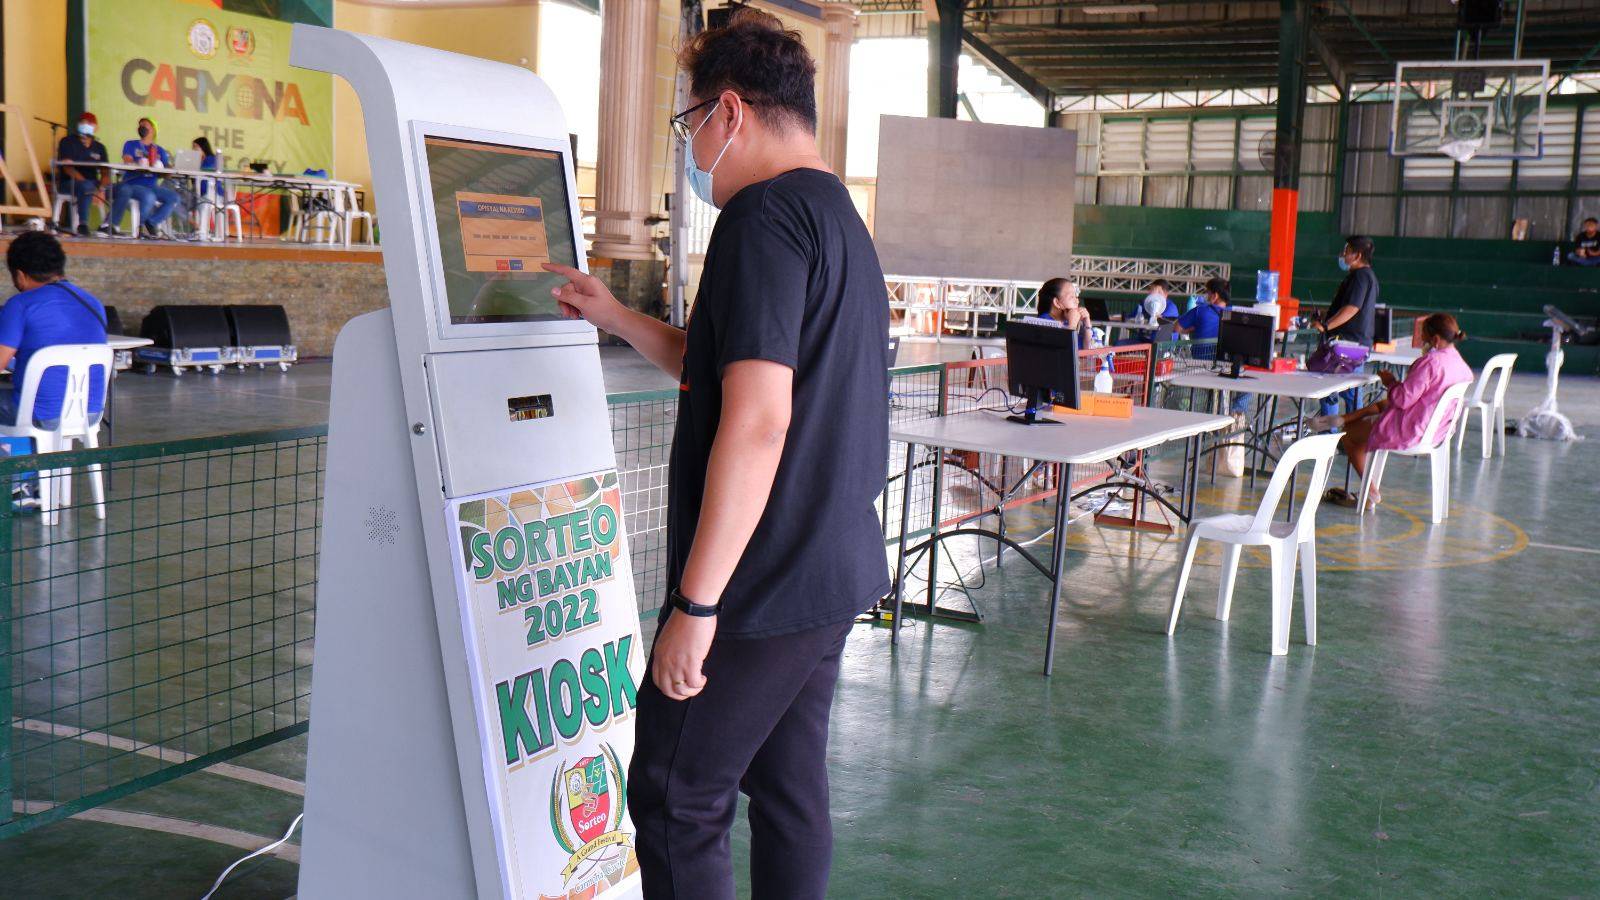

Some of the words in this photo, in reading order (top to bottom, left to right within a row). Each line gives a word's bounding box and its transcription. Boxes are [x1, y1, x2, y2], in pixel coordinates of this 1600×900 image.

[121, 58, 310, 126] CARMONA
[199, 125, 244, 149] THE
[471, 504, 618, 580] SORTEO
[496, 573, 534, 610] NG
[536, 552, 613, 598] BAYAN
[524, 588, 600, 646] 2022
[495, 634, 638, 765] KIOSK
[578, 812, 607, 834] Sorteo
